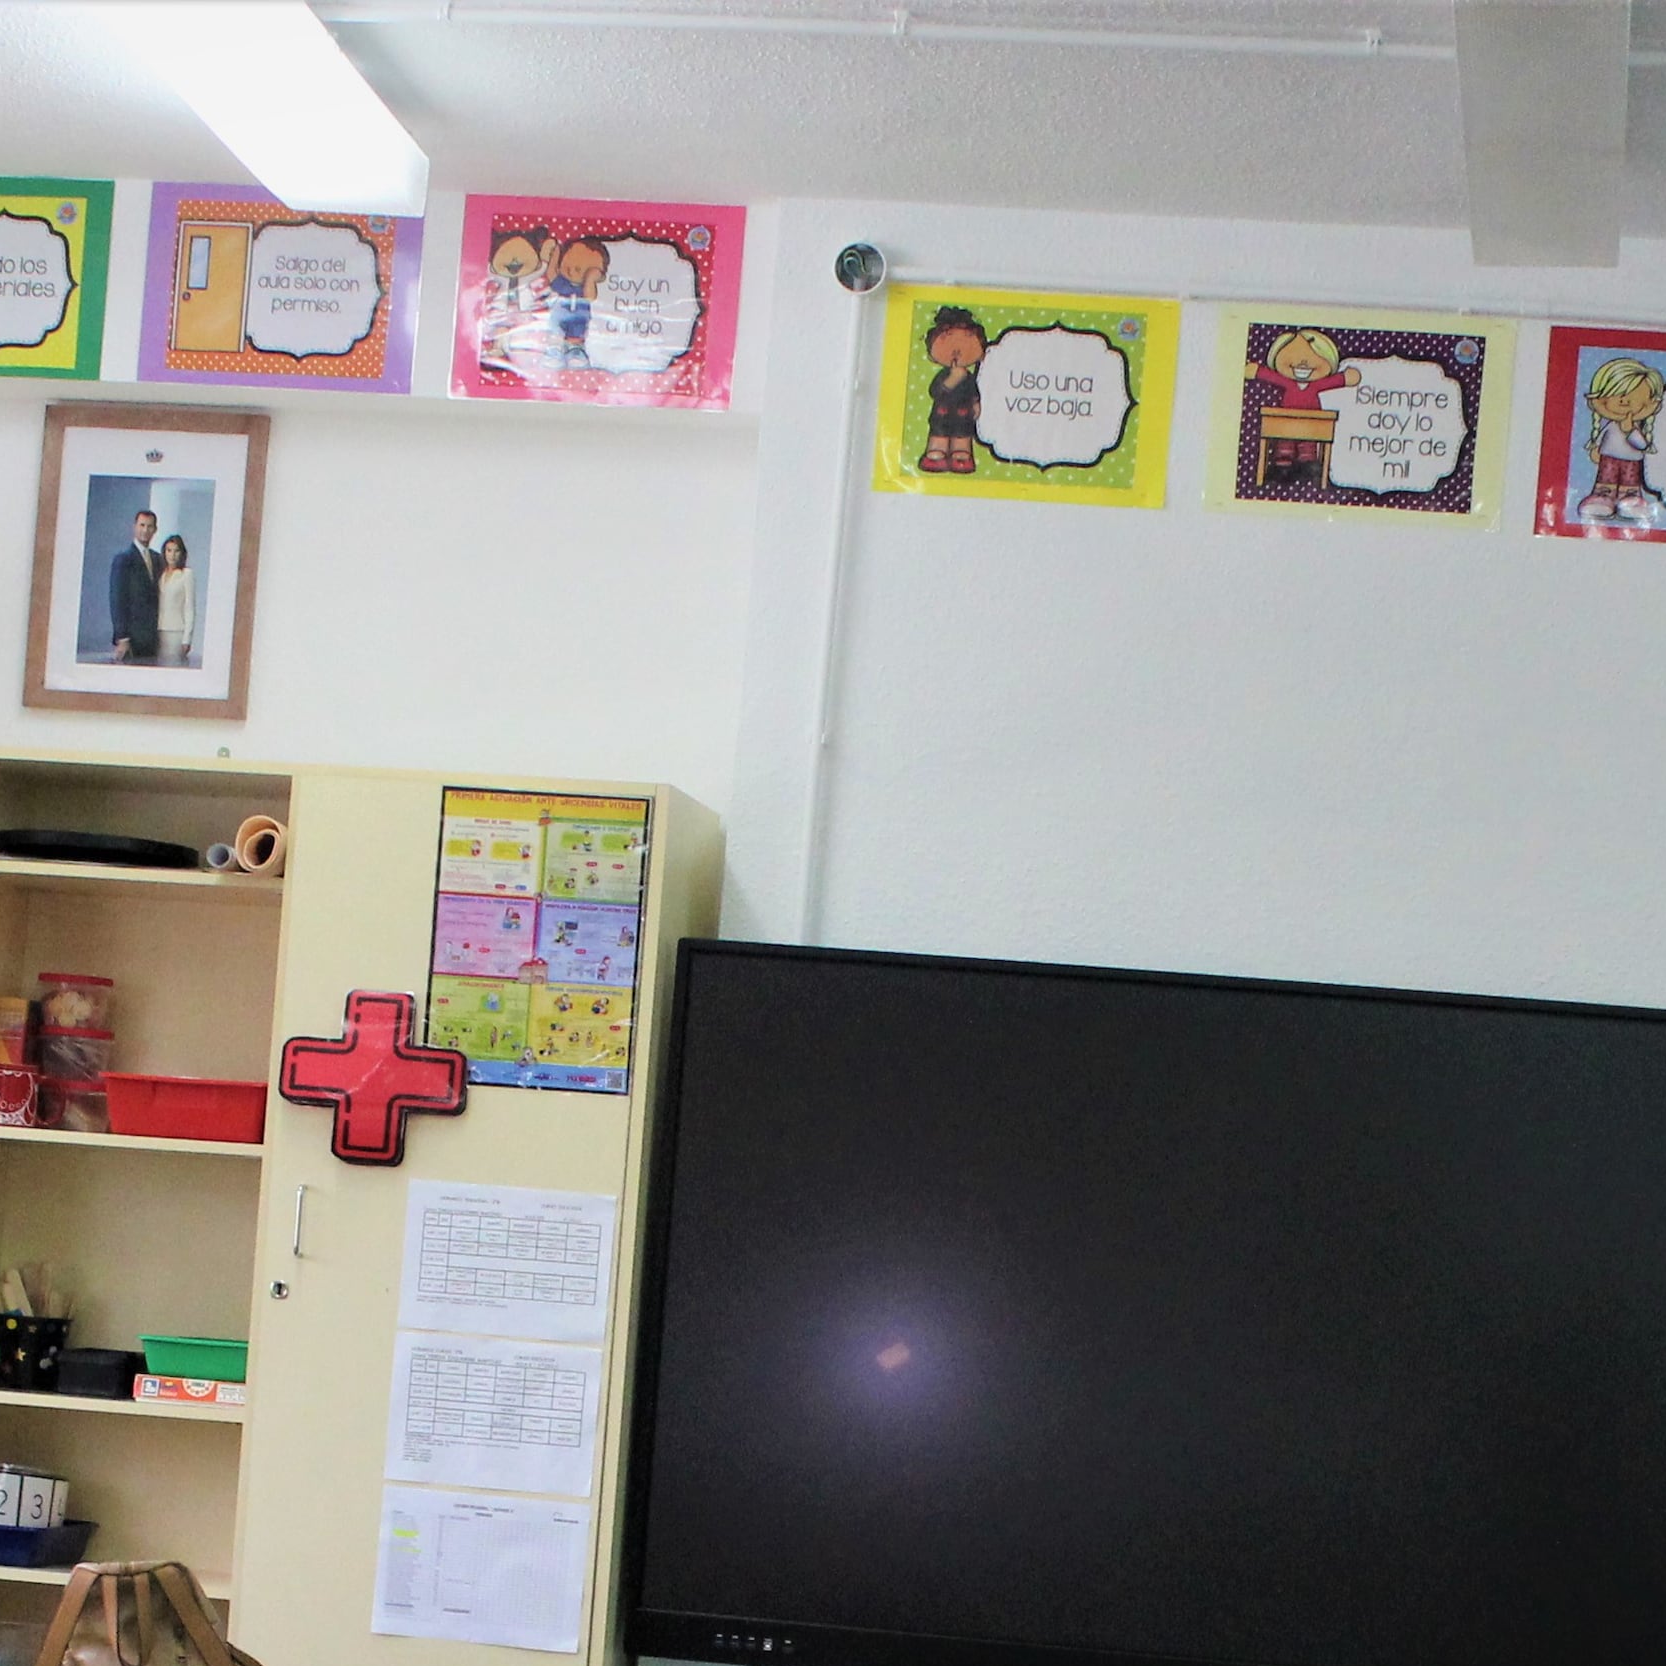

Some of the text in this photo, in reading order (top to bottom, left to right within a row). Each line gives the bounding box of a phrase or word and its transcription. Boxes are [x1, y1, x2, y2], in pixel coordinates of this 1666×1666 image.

[19, 257, 48, 275] los
[274, 255, 346, 275] Salgo del
[257, 275, 361, 292] aula solo con
[607, 274, 670, 296] Soy un
[613, 295, 660, 315] buen
[1008, 370, 1094, 394] Uso una
[1004, 396, 1044, 415] voz
[1367, 410, 1433, 436] doy lo
[1348, 434, 1447, 459] mejor de
[30, 1493, 45, 1520] 3
